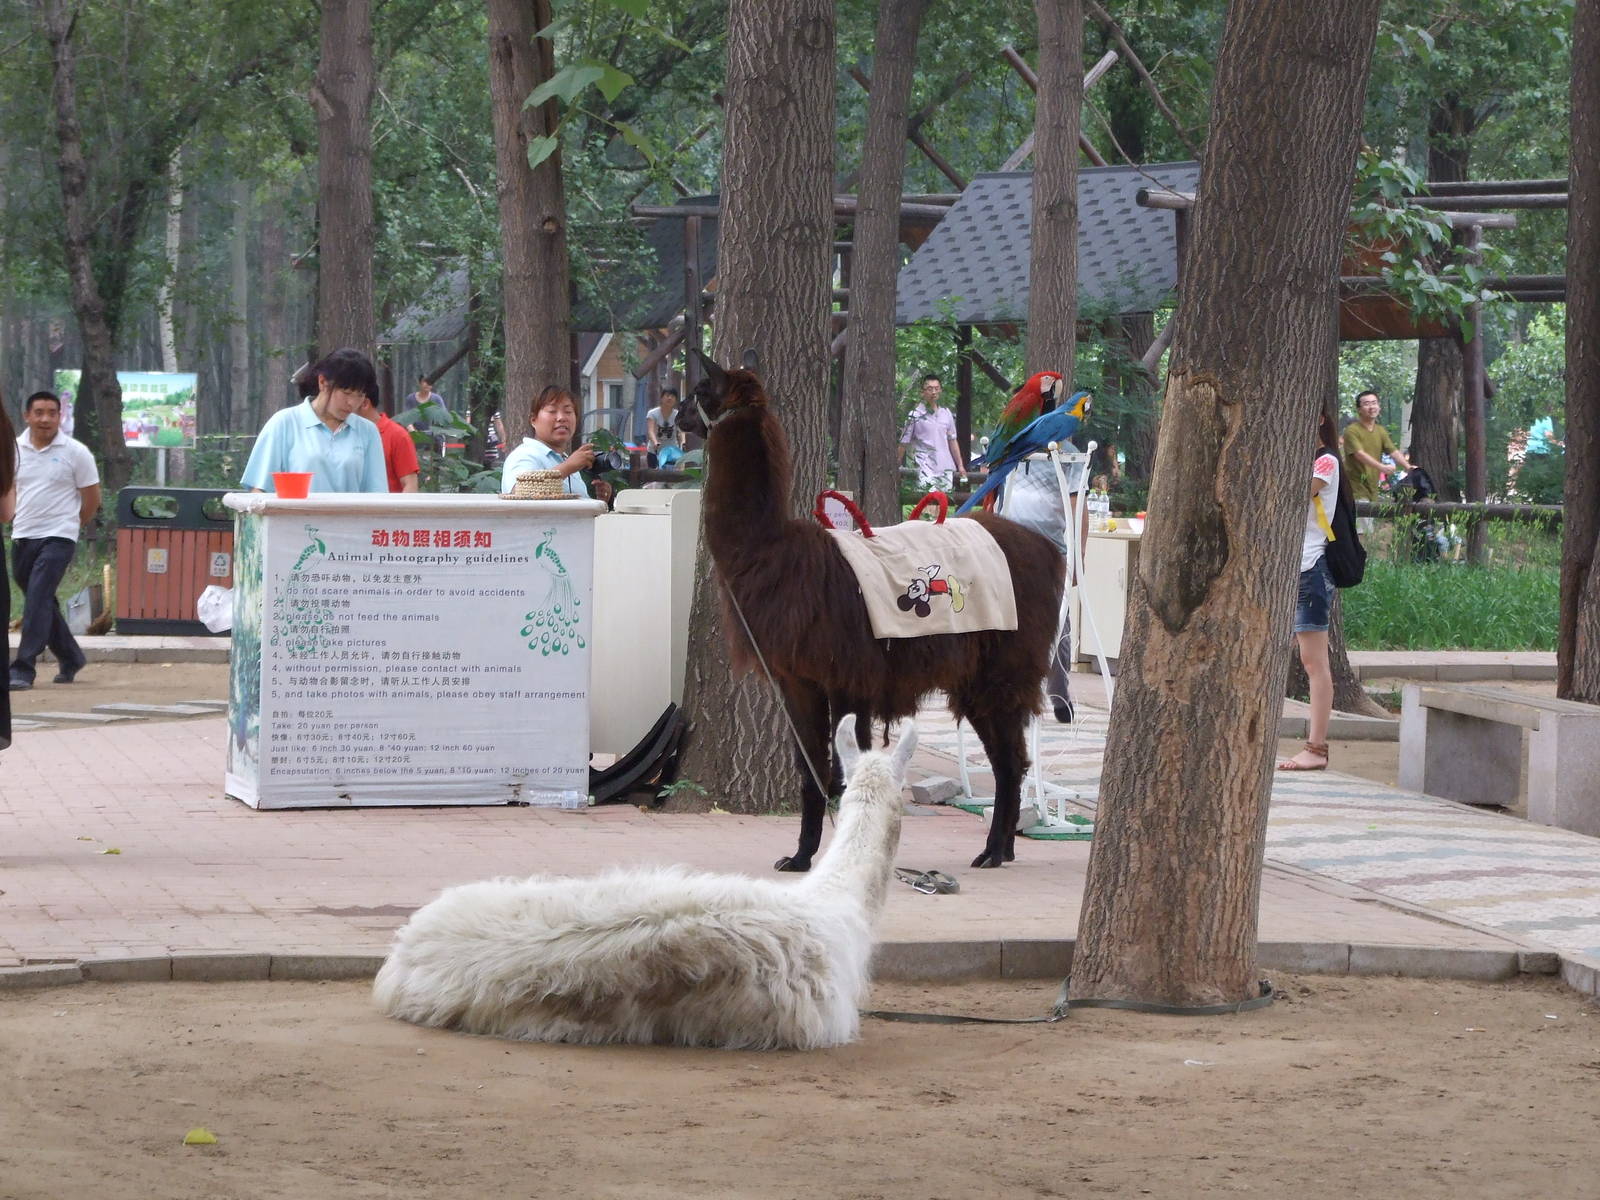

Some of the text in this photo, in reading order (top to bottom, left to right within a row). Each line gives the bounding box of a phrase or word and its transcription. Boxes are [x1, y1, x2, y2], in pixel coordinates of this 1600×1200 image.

[371, 529, 492, 548] 动物照相须知
[327, 551, 529, 565] Animal photography guidelines
[286, 587, 299, 596] do
[302, 587, 319, 596] not
[321, 588, 349, 596] scare
[352, 587, 391, 596] animals
[394, 587, 403, 596] in
[406, 587, 433, 597] order
[436, 588, 445, 597] to
[448, 588, 475, 597] avoid
[478, 588, 525, 597] accidents
[286, 612, 319, 623] please
[322, 613, 335, 621] do
[338, 613, 354, 621] not
[357, 613, 379, 621] feed
[382, 613, 399, 621] the
[401, 613, 440, 622] animals
[322, 638, 343, 647] take
[347, 638, 387, 649] pictures
[285, 664, 321, 673] without
[385, 664, 418, 675] please
[421, 665, 458, 674] contact
[461, 665, 481, 673] with
[484, 665, 522, 673] animals
[284, 690, 303, 698] and
[306, 690, 328, 698] take
[331, 690, 365, 700] photos
[368, 690, 388, 699] with
[436, 690, 469, 701] please
[472, 690, 496, 700] obey
[499, 690, 521, 699] staff
[524, 690, 585, 701] arrangement
[297, 722, 308, 730] 20
[311, 722, 331, 731] yuan
[334, 722, 348, 731] per
[350, 722, 379, 731] person
[320, 745, 337, 753] inch
[430, 744, 440, 752] 12
[462, 744, 473, 752] 60
[475, 745, 495, 753] yuan
[343, 767, 371, 775] inches
[373, 767, 398, 775] below
[401, 767, 414, 775] the
[512, 767, 539, 775] inches
[565, 767, 585, 775] yuan
